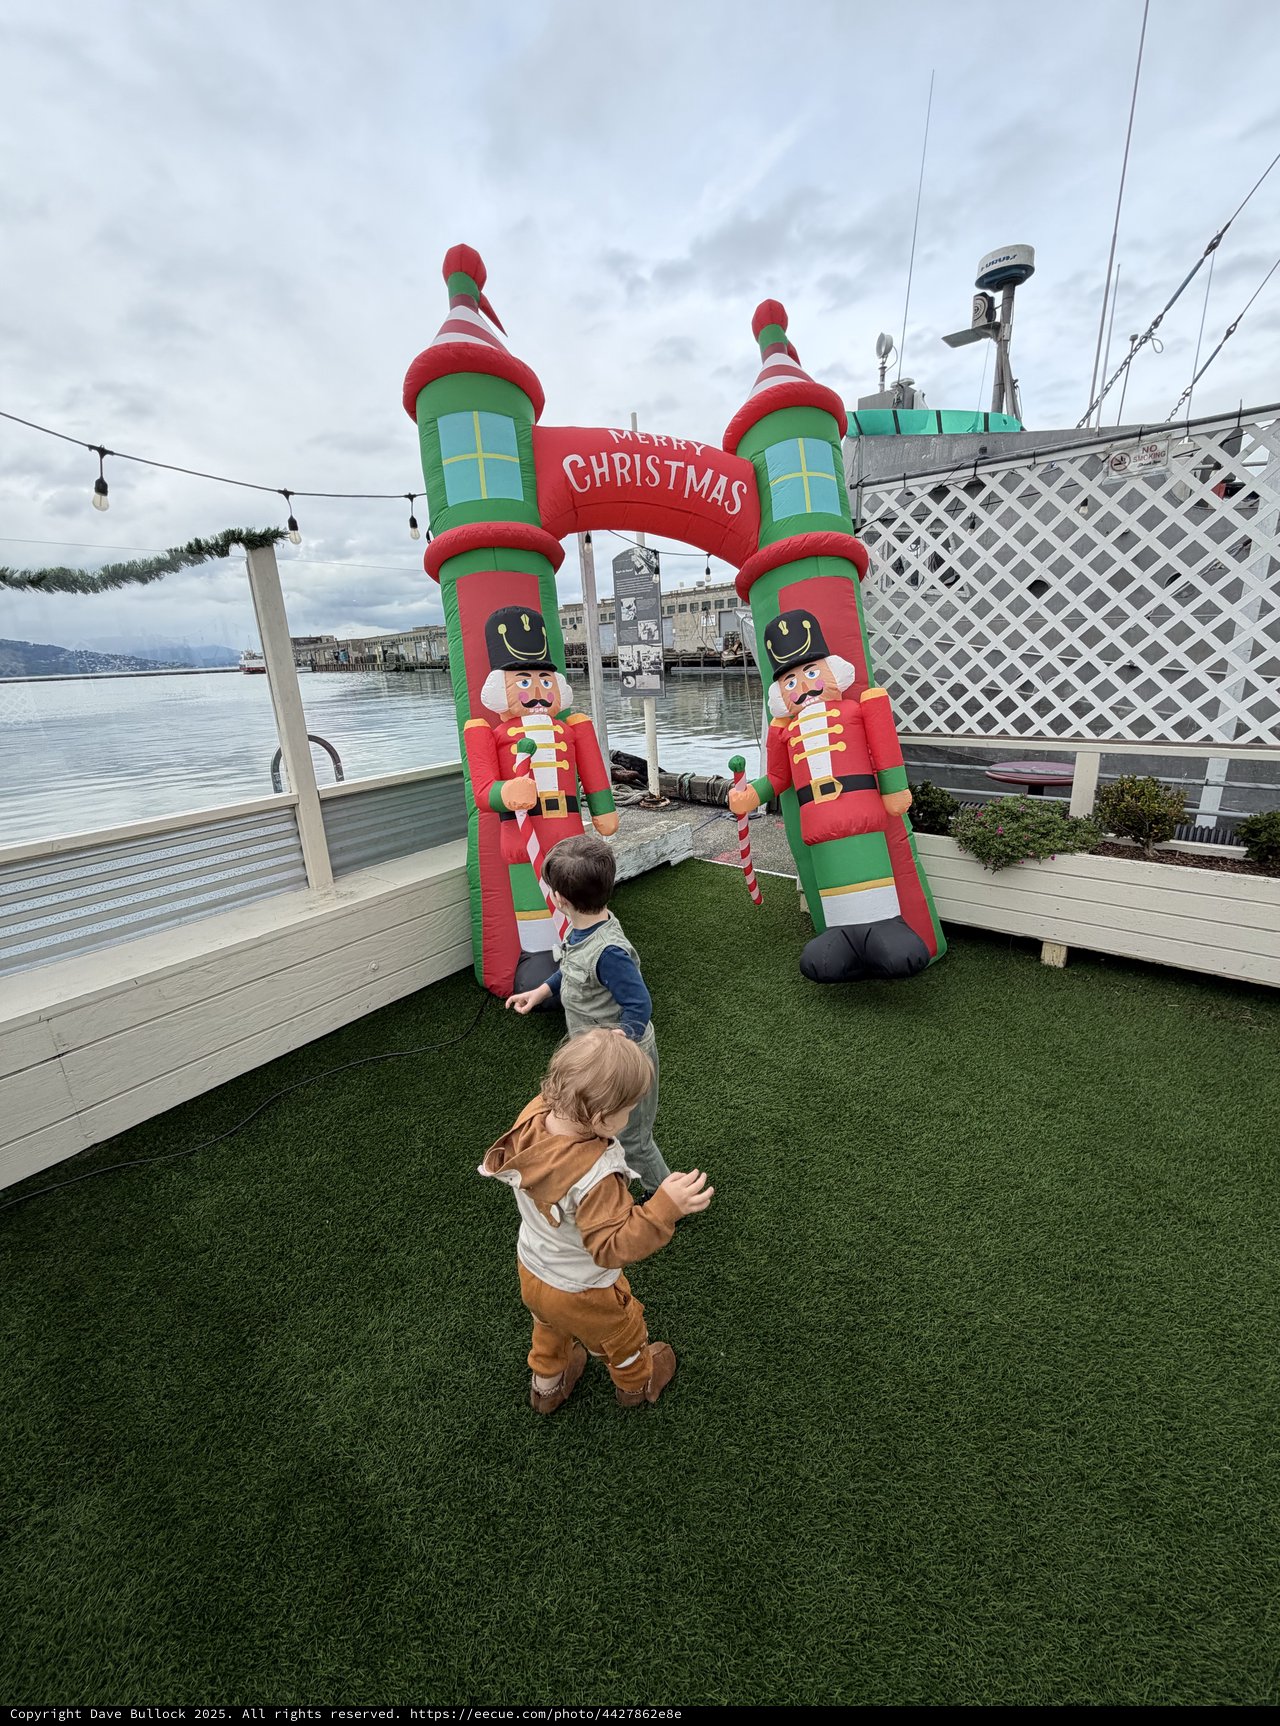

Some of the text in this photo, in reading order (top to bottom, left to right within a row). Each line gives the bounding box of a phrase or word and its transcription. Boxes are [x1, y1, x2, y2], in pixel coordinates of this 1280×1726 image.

[608, 429, 705, 456] MERRY
[1142, 444, 1157, 454] NO
[1132, 450, 1166, 463] SMOKING
[562, 452, 747, 515] CHRISTMAS
